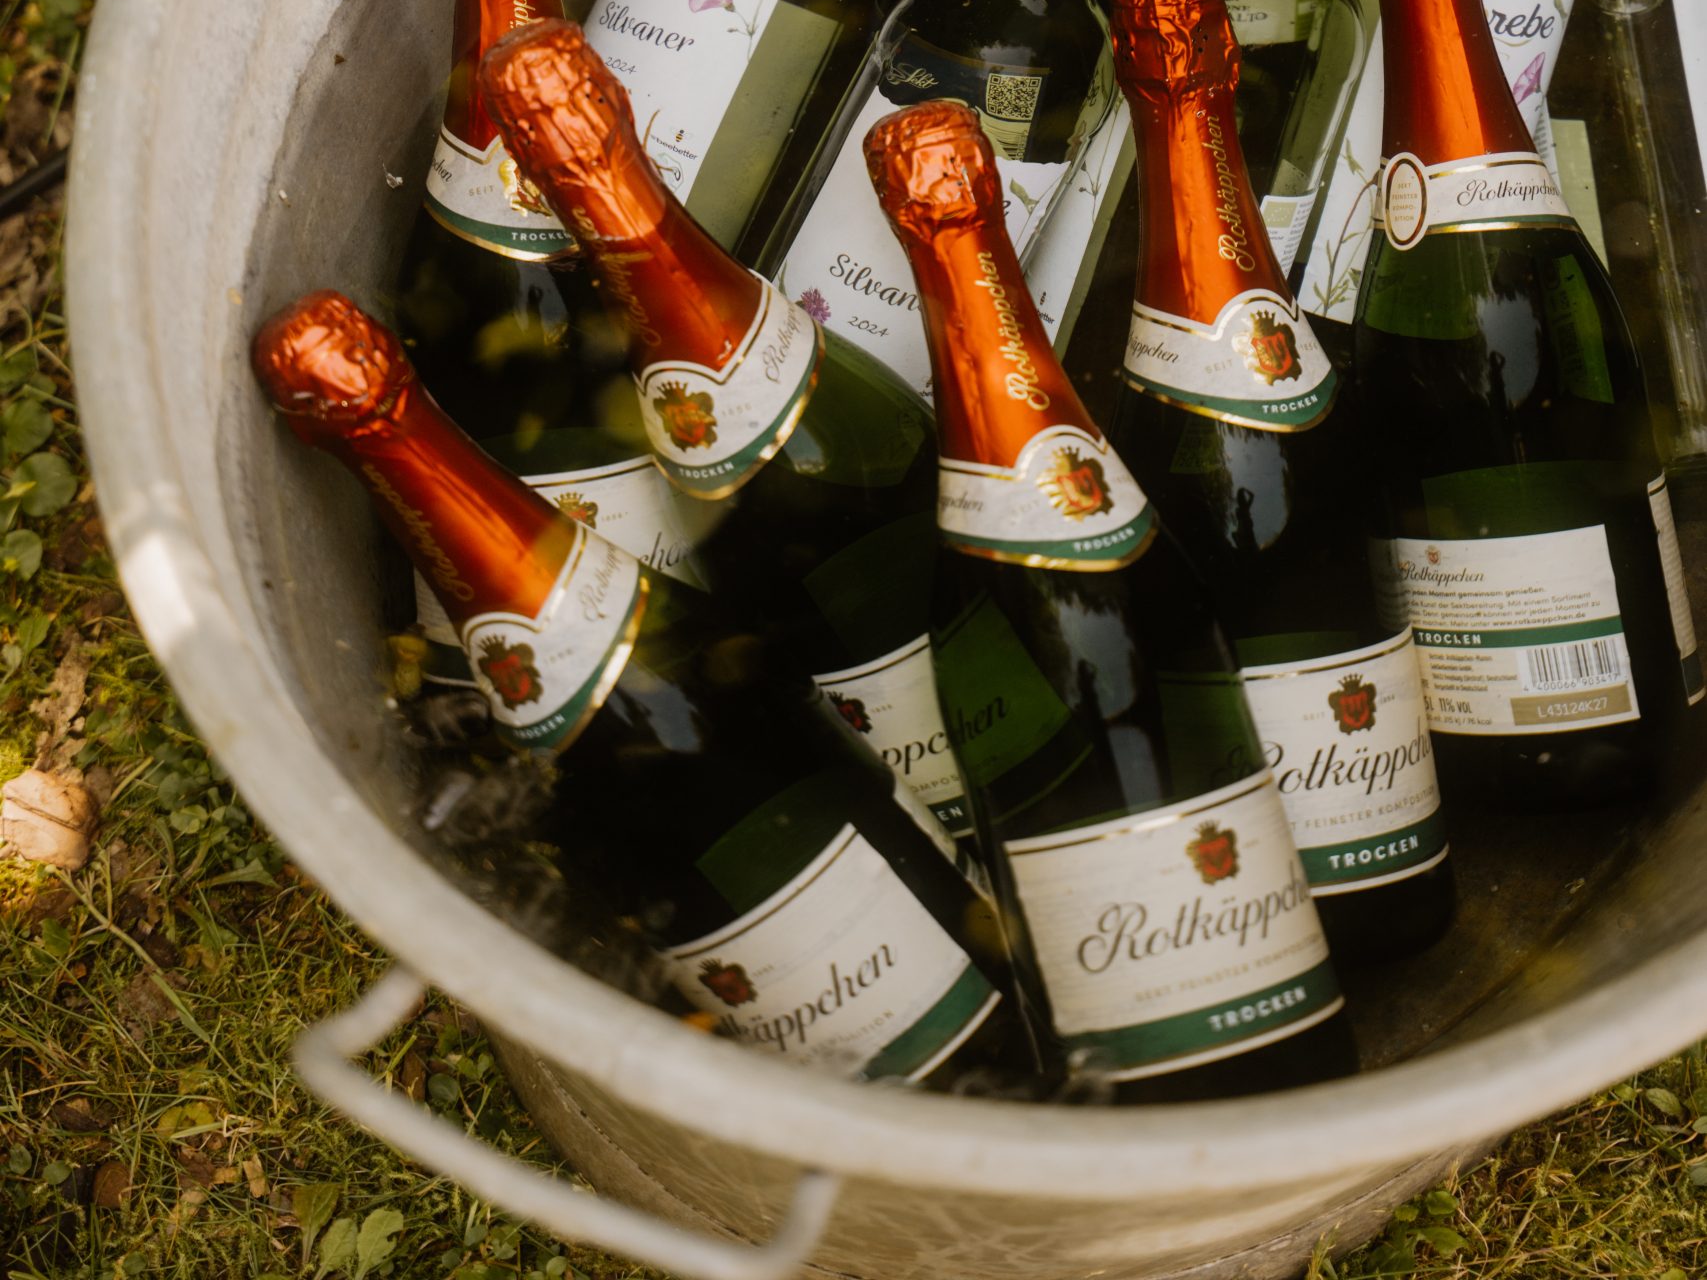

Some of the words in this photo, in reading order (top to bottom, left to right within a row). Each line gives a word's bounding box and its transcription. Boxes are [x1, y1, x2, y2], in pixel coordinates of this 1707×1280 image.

[600, 1, 695, 53] Silvaner
[1488, 3, 1555, 40] rebe
[604, 56, 638, 75] 2024
[1202, 114, 1256, 272] Rotkäppchen
[829, 253, 925, 314] Silvan
[847, 315, 890, 338] 2024
[974, 250, 1050, 411] Rotkäppchen
[1261, 393, 1319, 416] TROCKEN
[678, 460, 735, 480] TROCKEN
[1072, 527, 1136, 554] TROCKEN
[1400, 561, 1485, 587] Rotkäppchen
[1439, 696, 1456, 714] 11%
[1457, 700, 1473, 715] VOL
[1304, 808, 1374, 830] FEINSTER
[1328, 834, 1420, 871] TROCKEN
[1076, 860, 1312, 974] Rotkäppch
[1208, 985, 1308, 1032] TROCKEN
